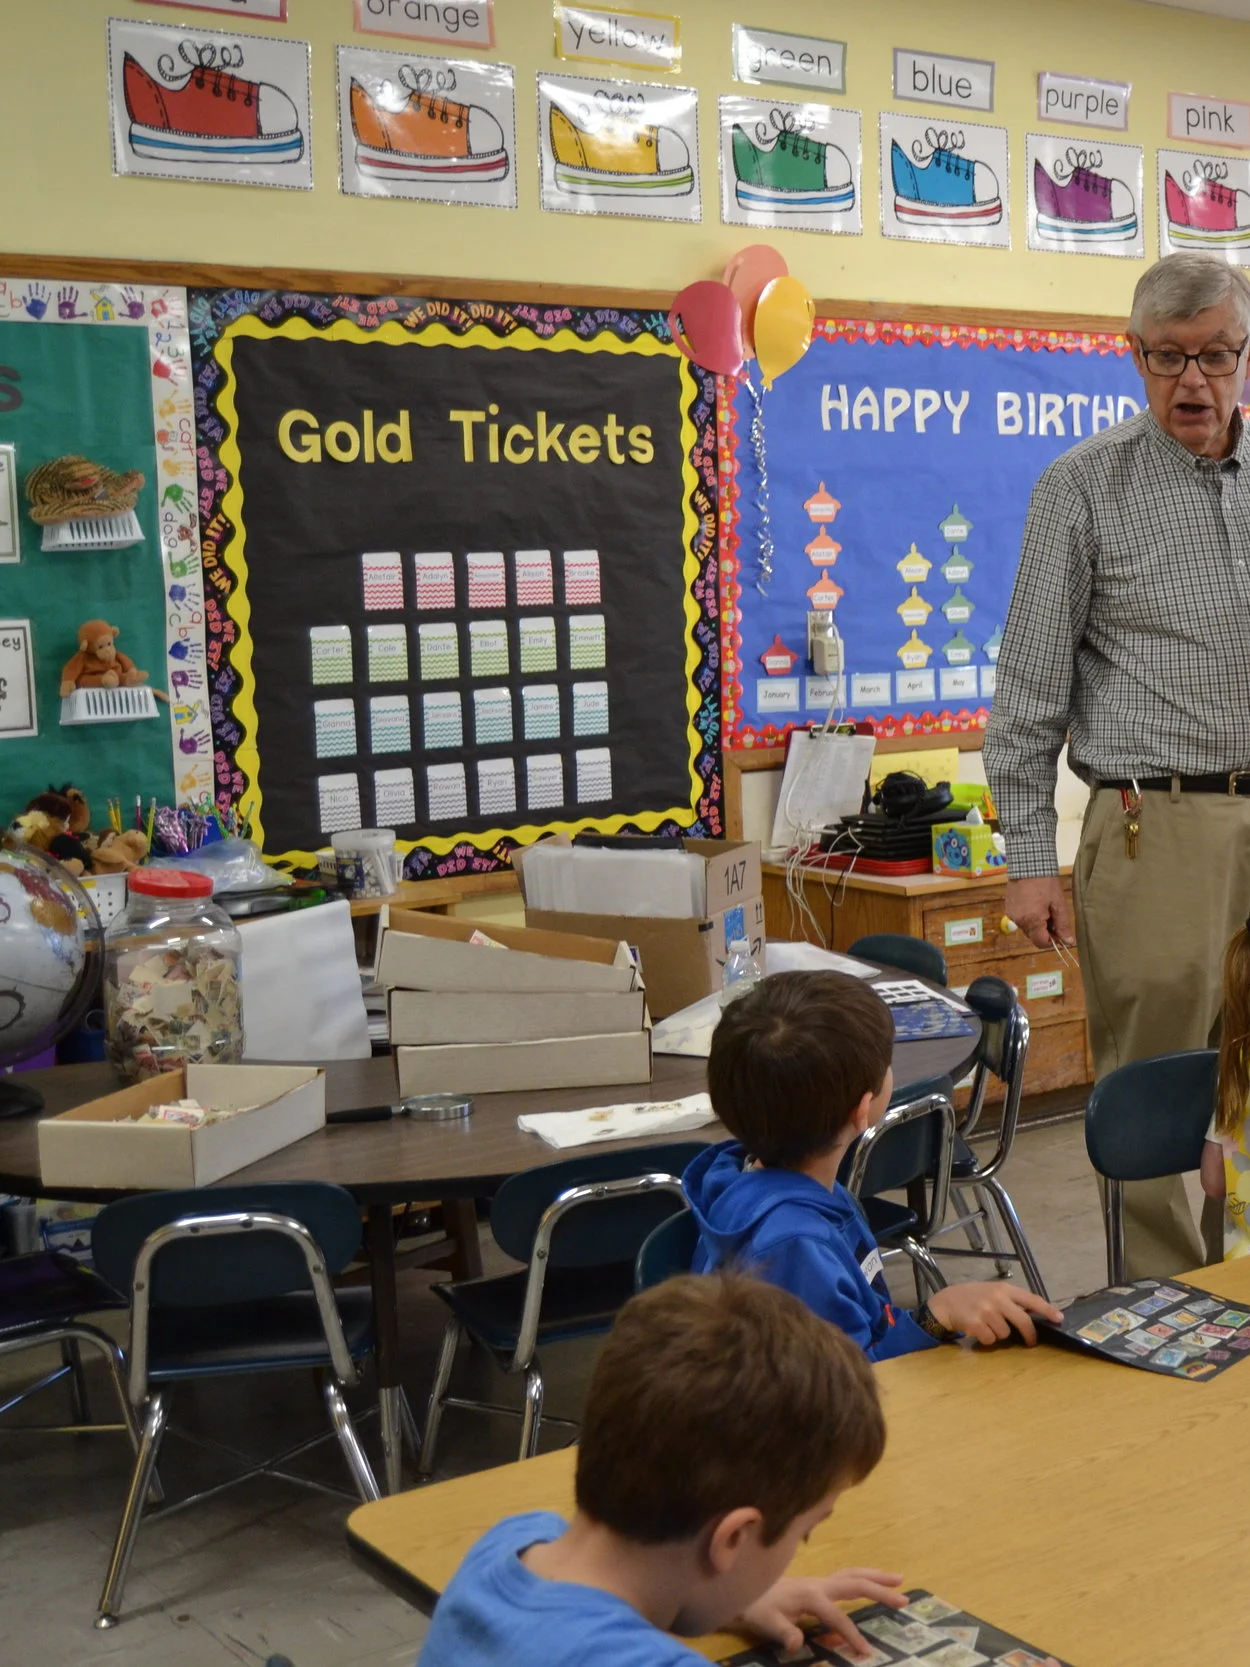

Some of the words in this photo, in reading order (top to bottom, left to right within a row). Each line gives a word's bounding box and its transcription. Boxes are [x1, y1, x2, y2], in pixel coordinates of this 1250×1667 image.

[367, 0, 482, 33] orange
[566, 11, 667, 51] yellow
[748, 43, 834, 76] green
[912, 61, 973, 98] blue
[1044, 85, 1120, 118] purple
[1185, 104, 1236, 134] pink
[404, 305, 425, 329] WE
[427, 301, 449, 317] DID
[451, 304, 475, 331] IT!
[820, 384, 970, 435] HAPPY
[995, 391, 1147, 437] BIRTHD
[178, 418, 194, 457] cat
[278, 408, 413, 464] Gold
[450, 403, 655, 465] Tickets
[163, 511, 178, 549] dog
[763, 690, 791, 701] January
[860, 685, 881, 694] March
[907, 680, 923, 691] April
[952, 679, 965, 688] May
[724, 860, 747, 896] 1A7
